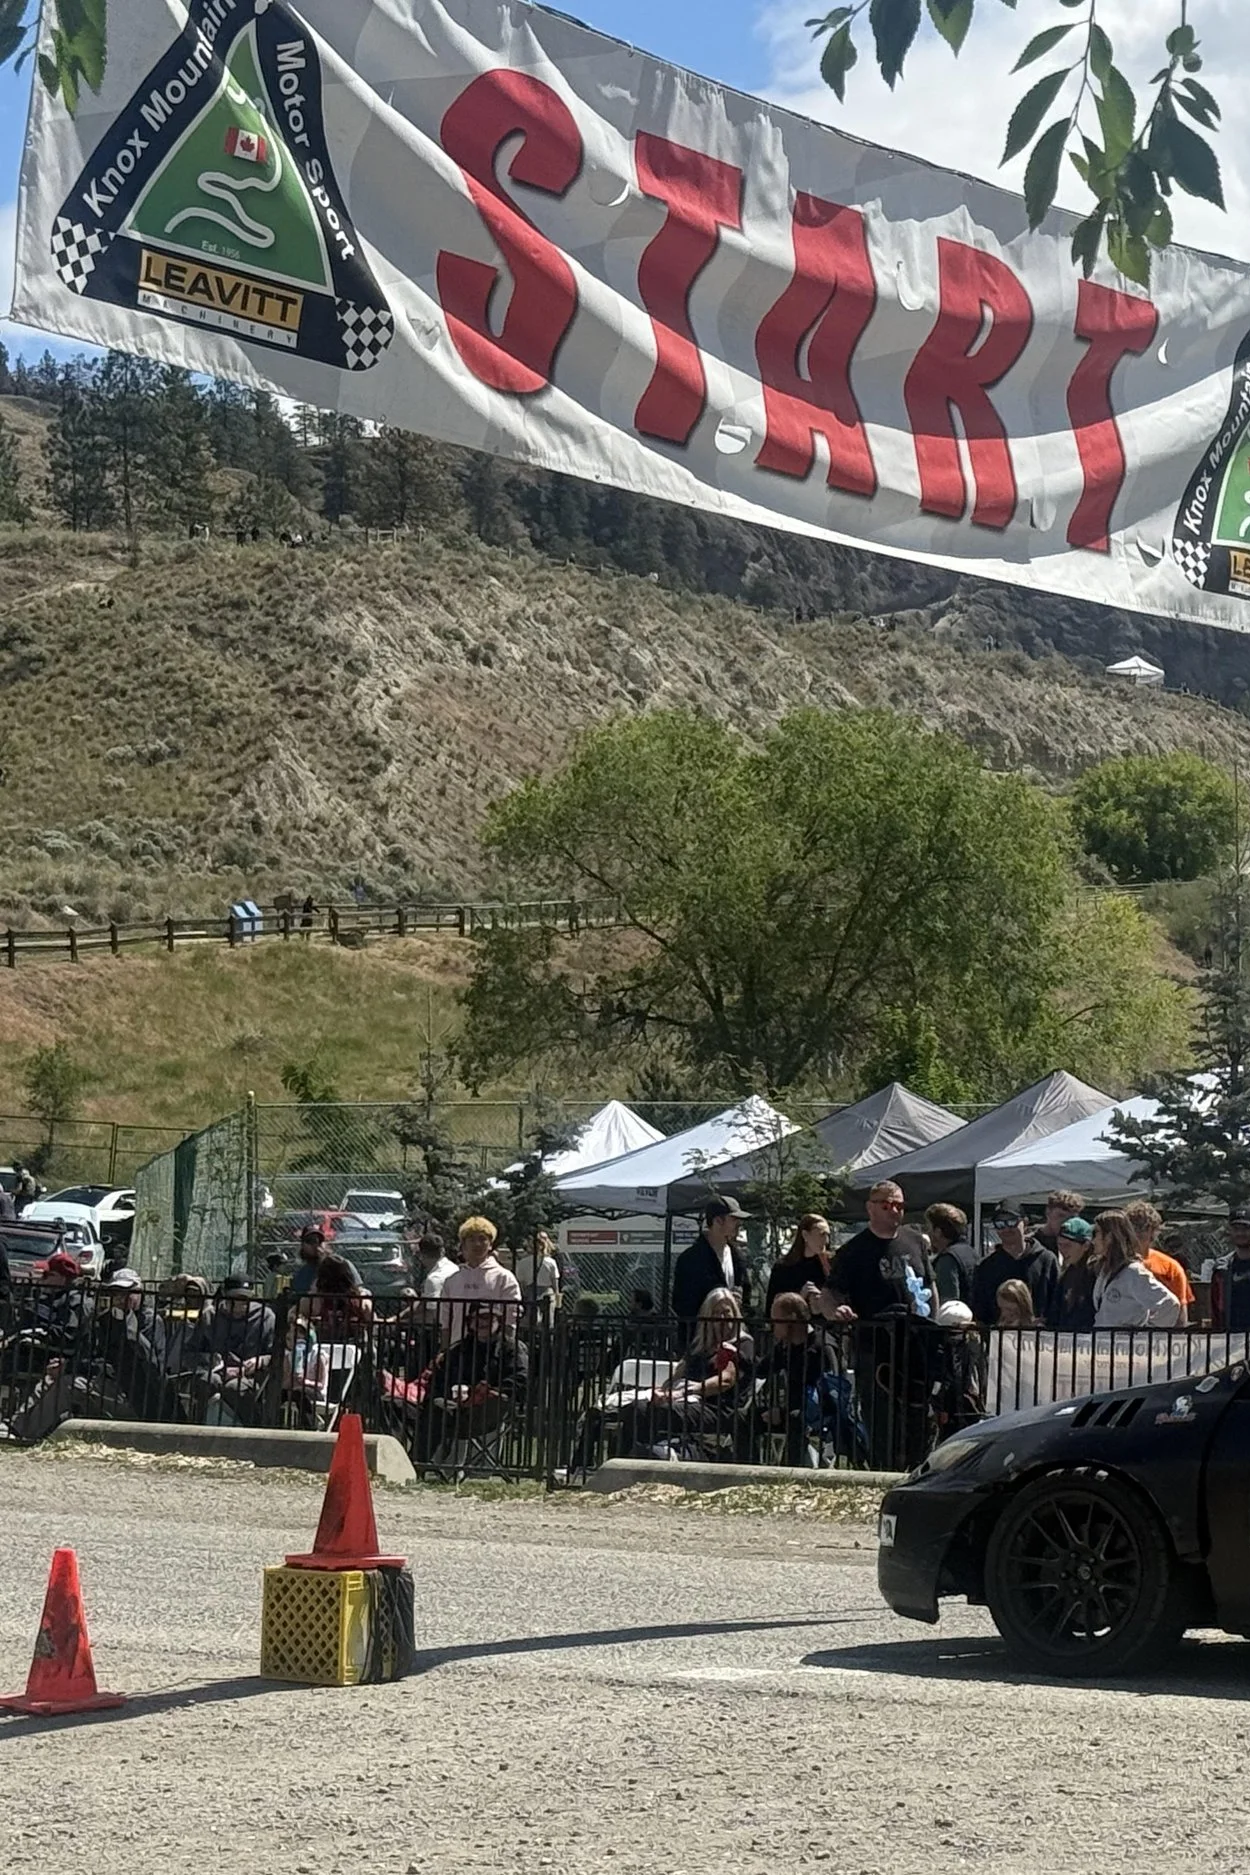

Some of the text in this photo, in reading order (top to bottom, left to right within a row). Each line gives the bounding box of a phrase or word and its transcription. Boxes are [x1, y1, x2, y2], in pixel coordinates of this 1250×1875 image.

[83, 0, 237, 219] Knox Mountain
[276, 40, 356, 262] Motor Sport
[144, 256, 299, 322] LEAVITT
[437, 69, 1159, 554] START
[1182, 474, 1213, 536] Knox
